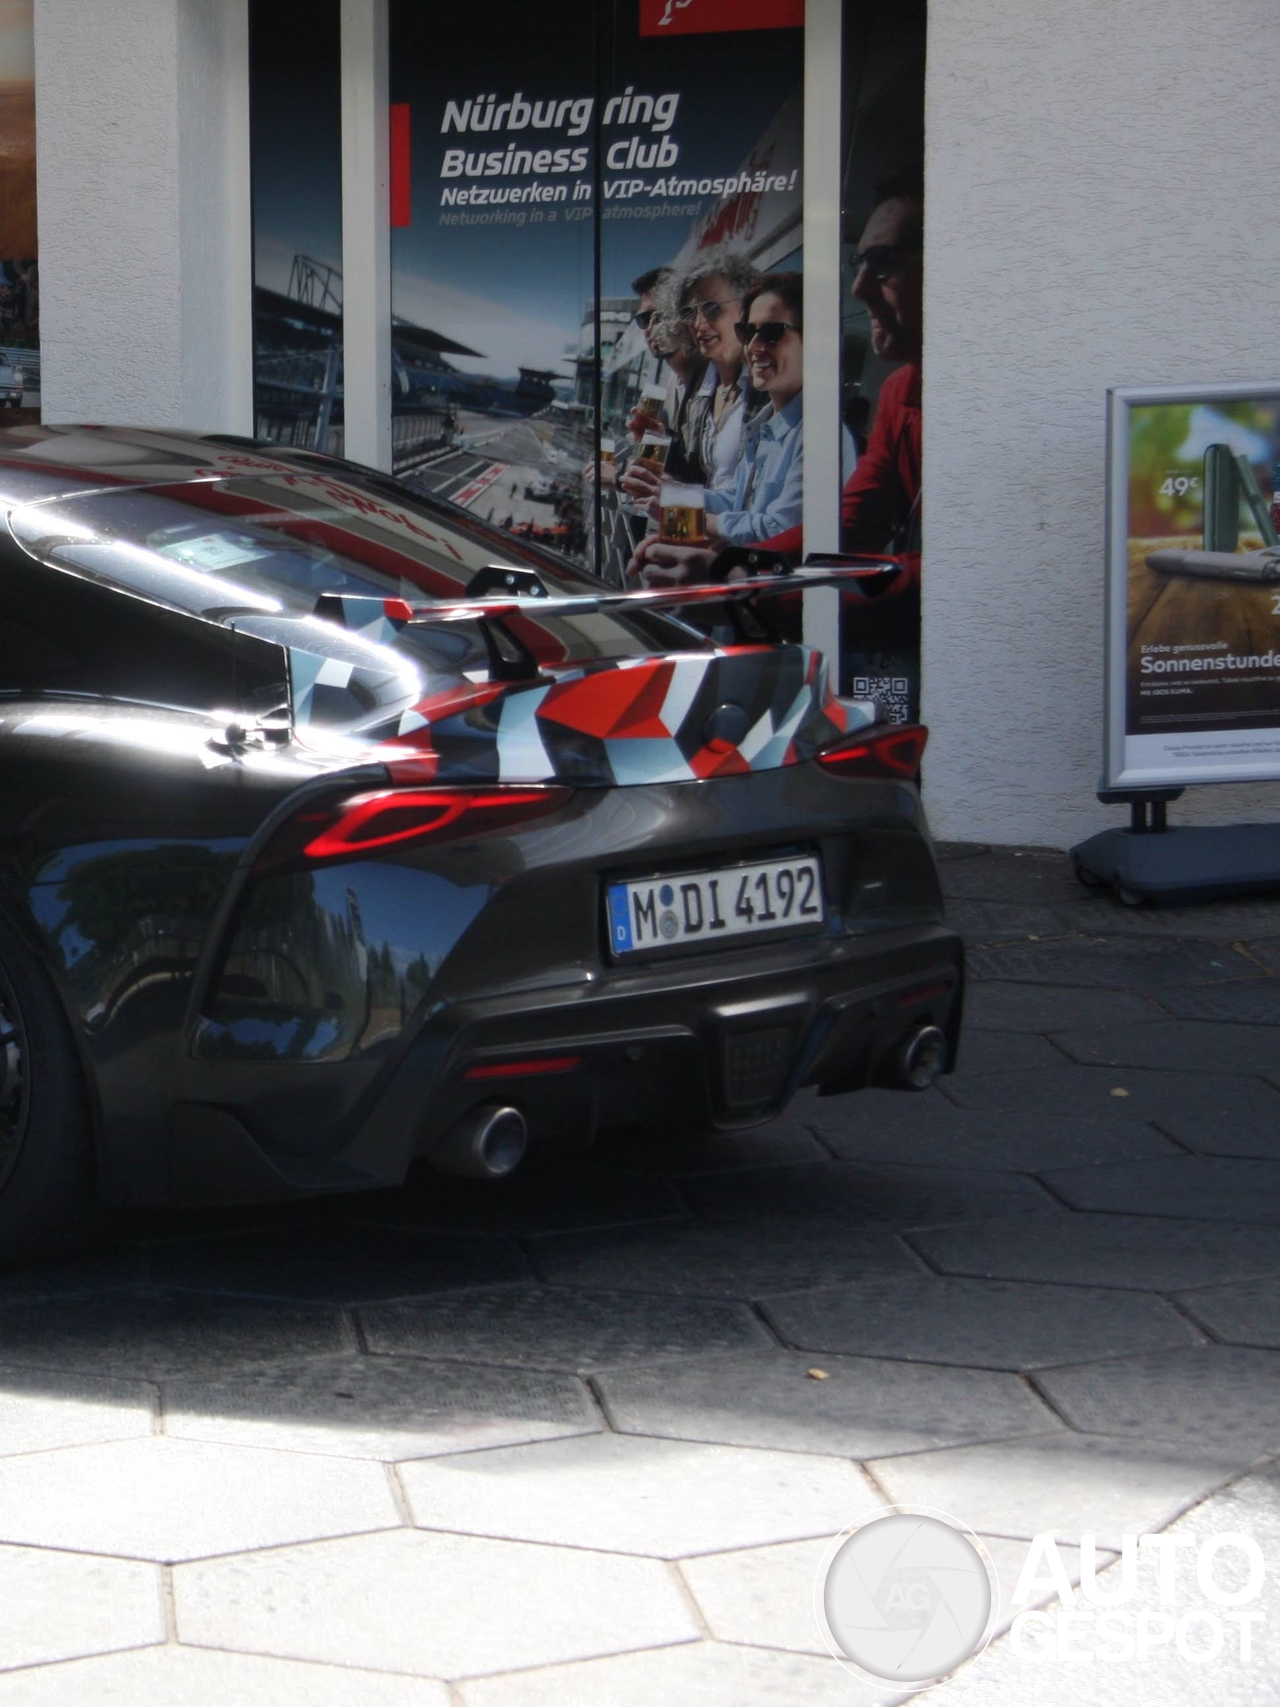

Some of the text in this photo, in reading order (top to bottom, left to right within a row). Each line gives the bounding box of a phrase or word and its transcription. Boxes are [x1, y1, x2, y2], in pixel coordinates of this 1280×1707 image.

[439, 135, 679, 178] Business Club
[440, 169, 798, 206] Netzwerken in VIP-Atmosphäre!
[439, 201, 702, 227] Networking in a VIP atmosphere!
[1140, 642, 1228, 654] Erlebe genussvolle
[632, 865, 818, 941] M DI 4192
[617, 926, 626, 941] D
